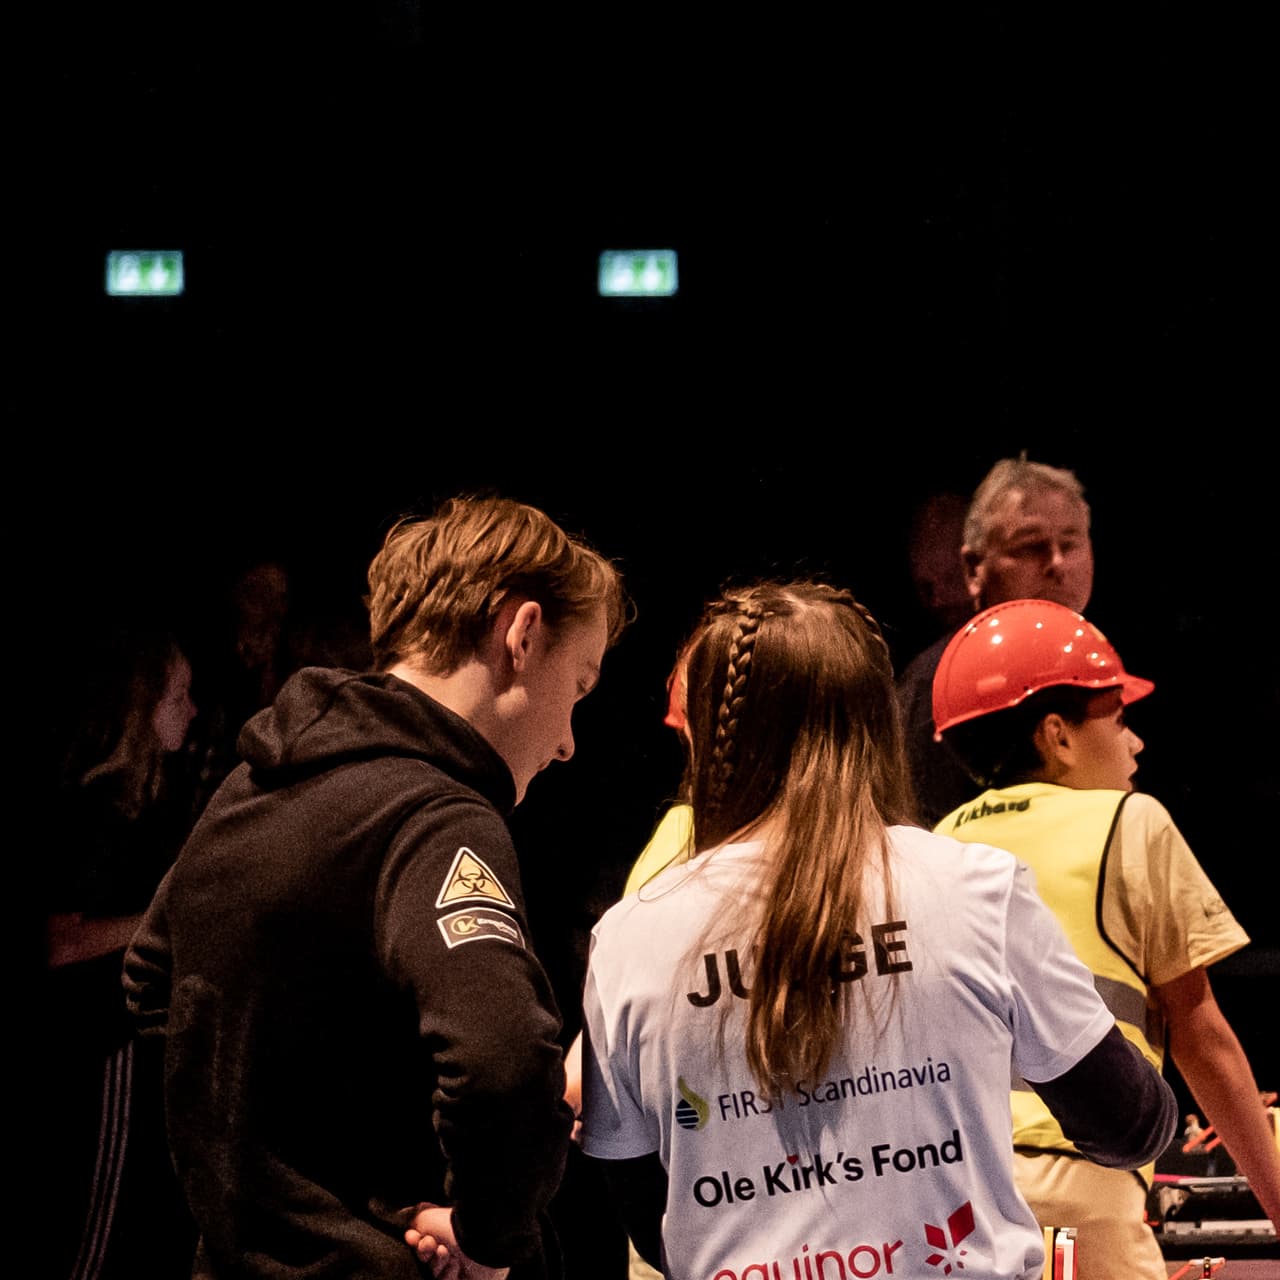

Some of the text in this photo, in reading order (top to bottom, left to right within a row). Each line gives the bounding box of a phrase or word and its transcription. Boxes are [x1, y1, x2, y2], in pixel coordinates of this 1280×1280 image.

[687, 920, 913, 1008] JUGE
[796, 1057, 951, 1107] Scandinavia
[693, 1171, 755, 1208] Ole
[871, 1129, 963, 1177] Fond
